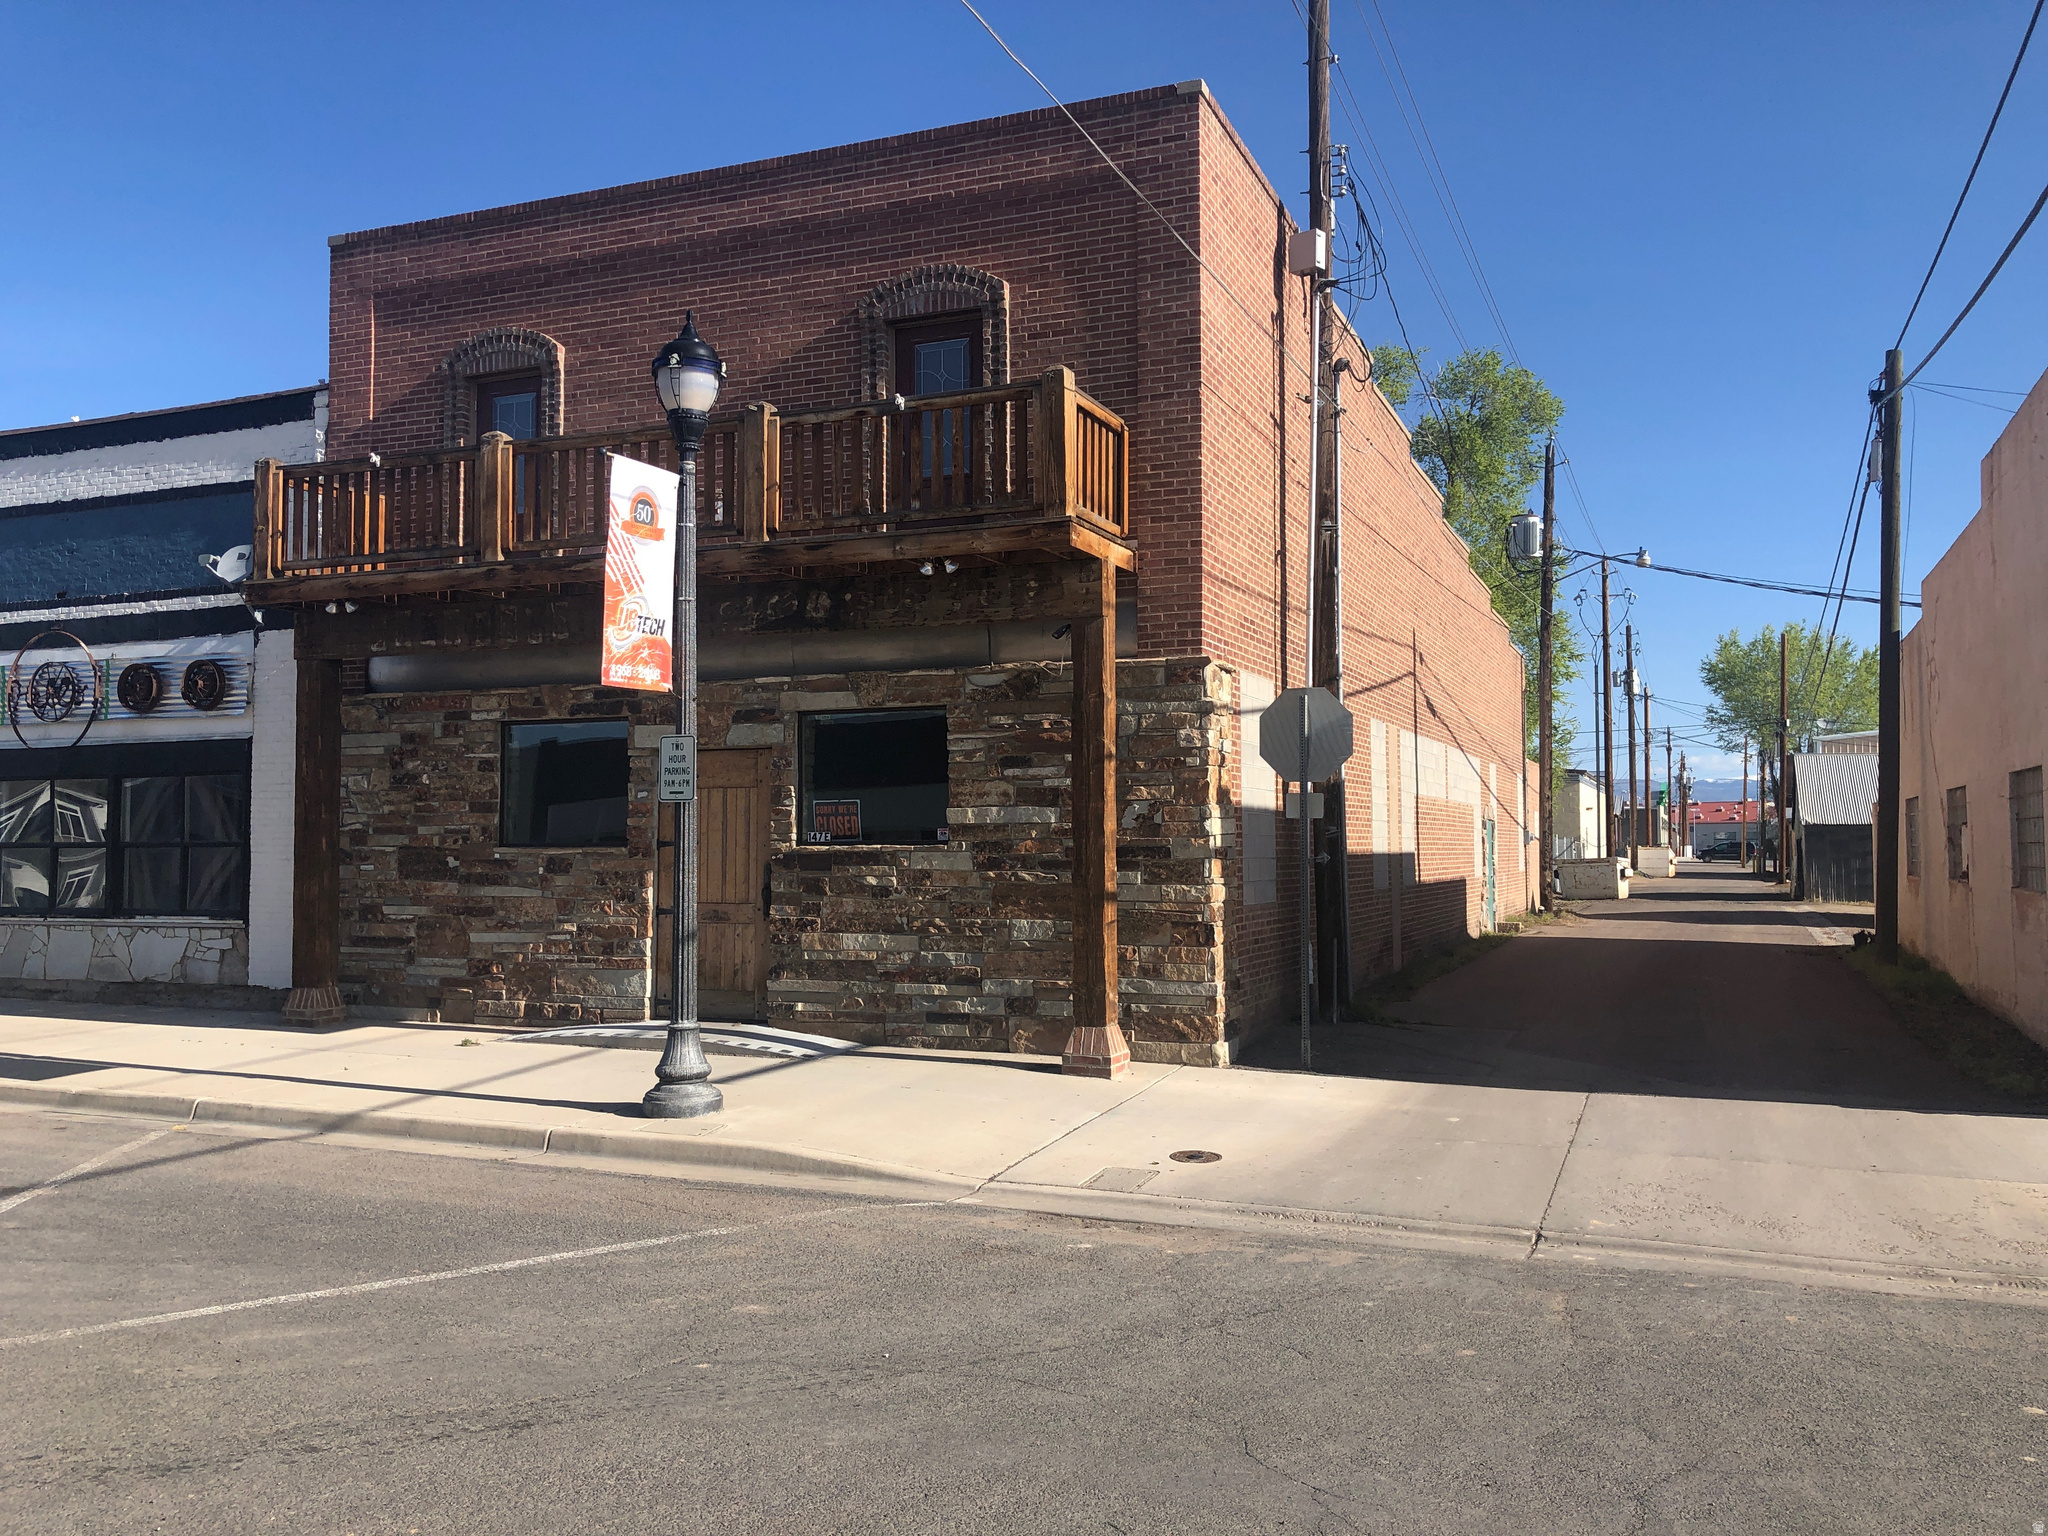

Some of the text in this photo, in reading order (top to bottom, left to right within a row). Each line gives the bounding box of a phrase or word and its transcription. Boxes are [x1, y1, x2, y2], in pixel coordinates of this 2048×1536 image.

[636, 503, 652, 523] 50
[671, 743, 685, 751] TWO
[668, 754, 687, 764] HOUR
[664, 766, 691, 776] PARKING
[663, 778, 691, 788] 9AM-6PM
[815, 804, 857, 814] SORRY WE'RE
[816, 815, 858, 836] CLOSED
